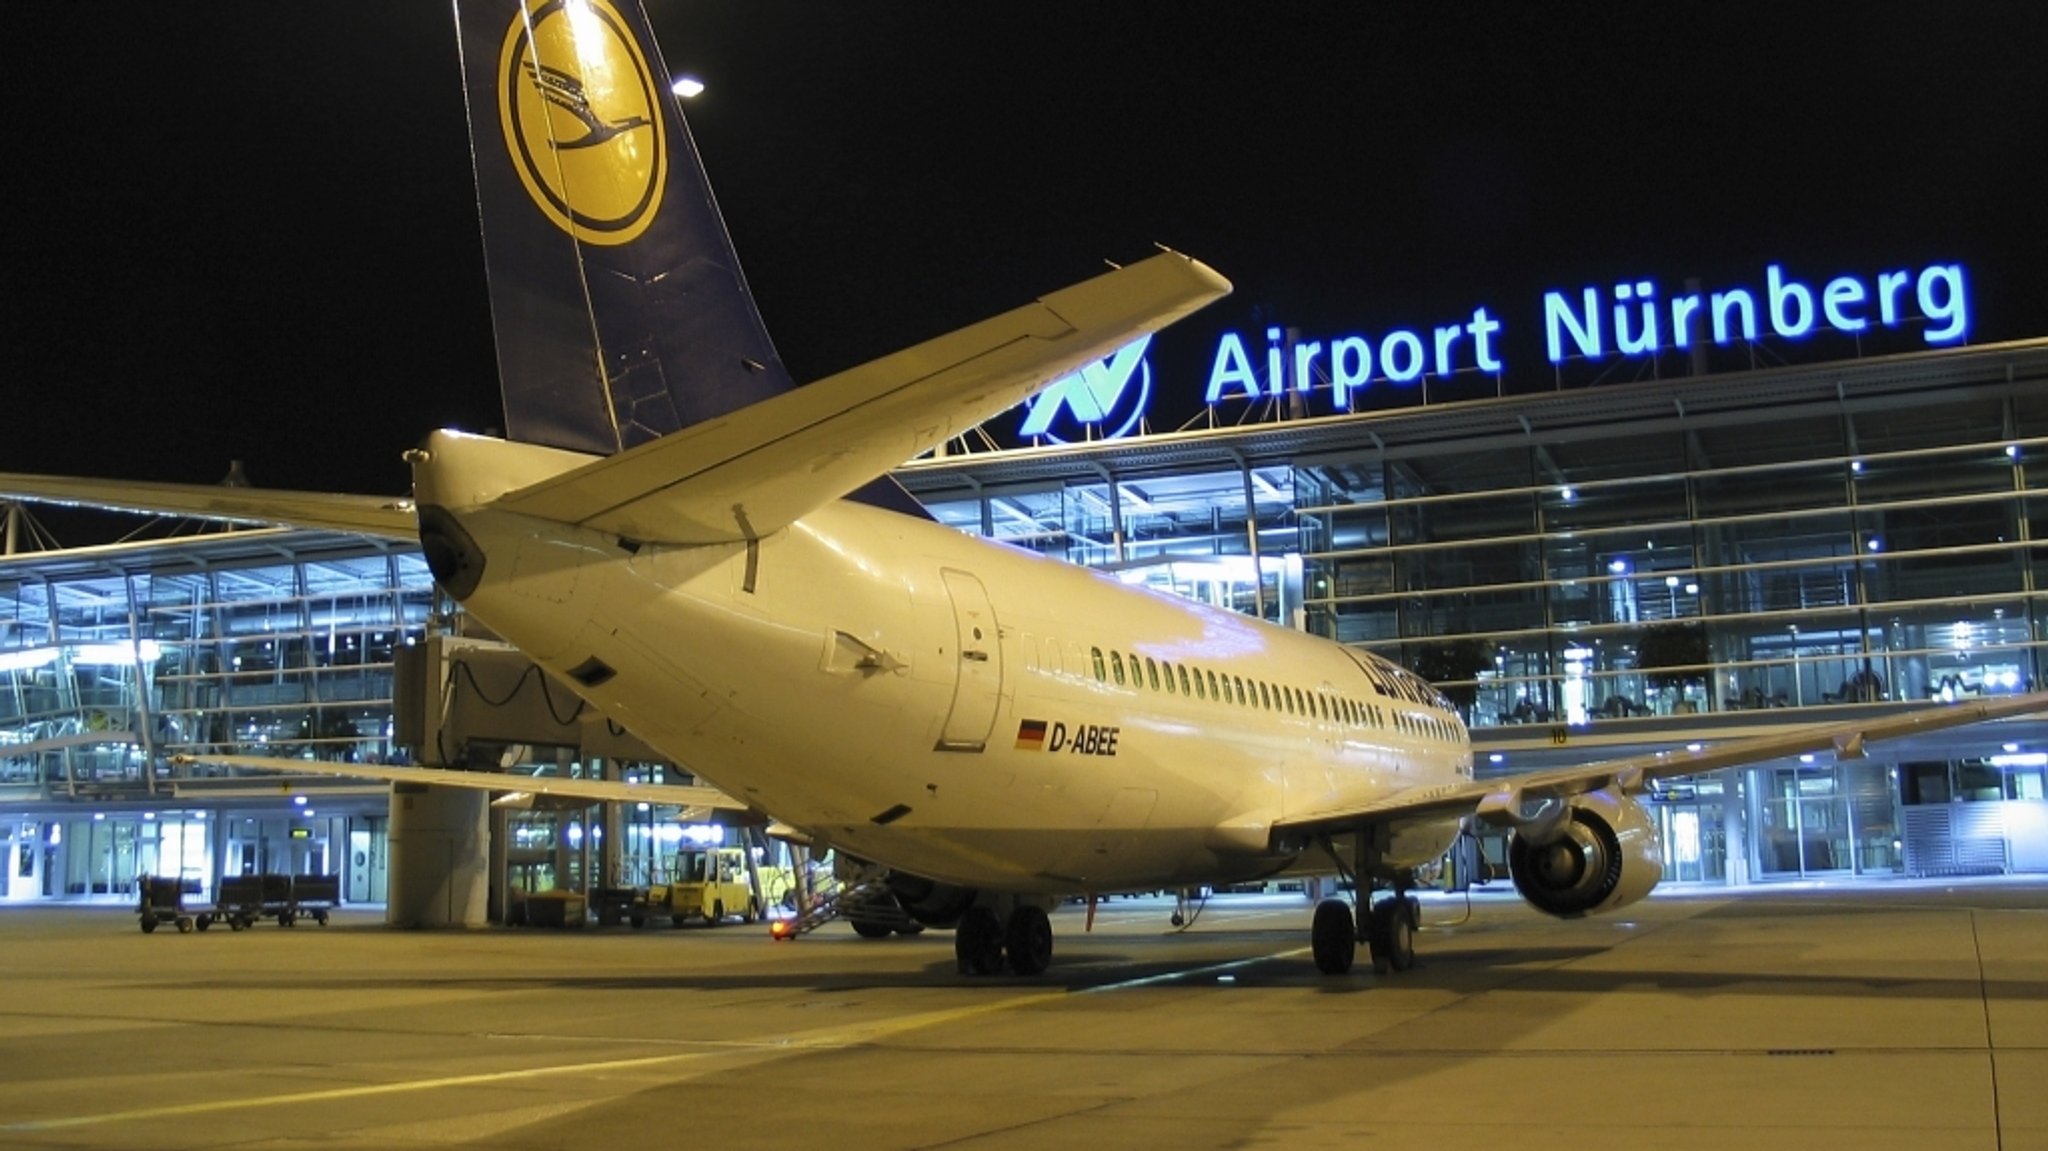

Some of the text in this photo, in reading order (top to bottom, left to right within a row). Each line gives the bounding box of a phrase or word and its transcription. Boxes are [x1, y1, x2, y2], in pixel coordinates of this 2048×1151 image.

[1206, 264, 1966, 408] Airport Nürnberg
[1048, 721, 1120, 756] D-ABEE
[1552, 727, 1567, 744] 10
